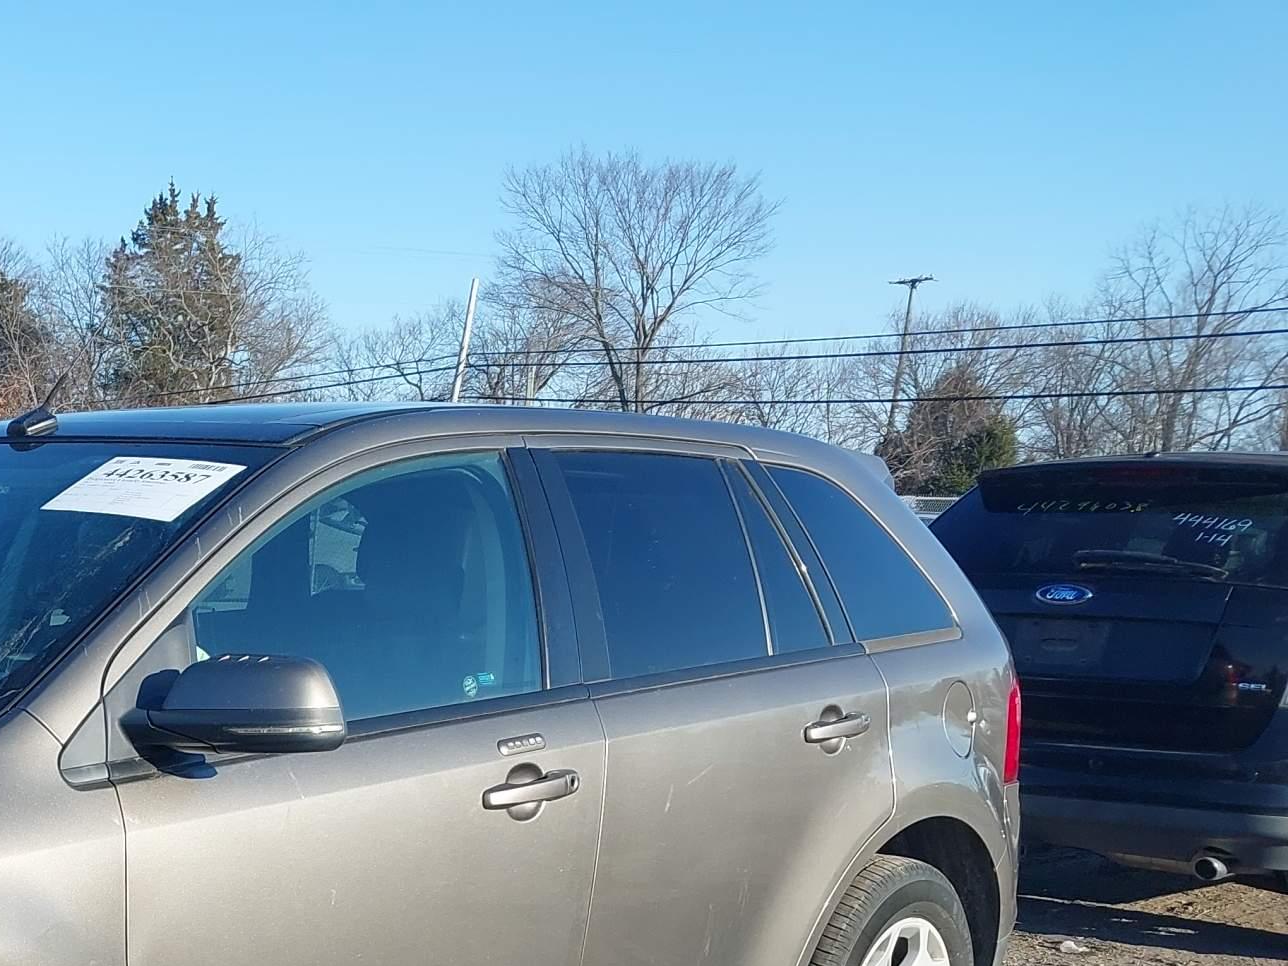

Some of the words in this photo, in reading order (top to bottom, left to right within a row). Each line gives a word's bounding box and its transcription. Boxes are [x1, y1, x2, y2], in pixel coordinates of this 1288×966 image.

[104, 467, 211, 484] 44263587
[1172, 513, 1253, 531] 444169
[1194, 532, 1233, 546] 1-14
